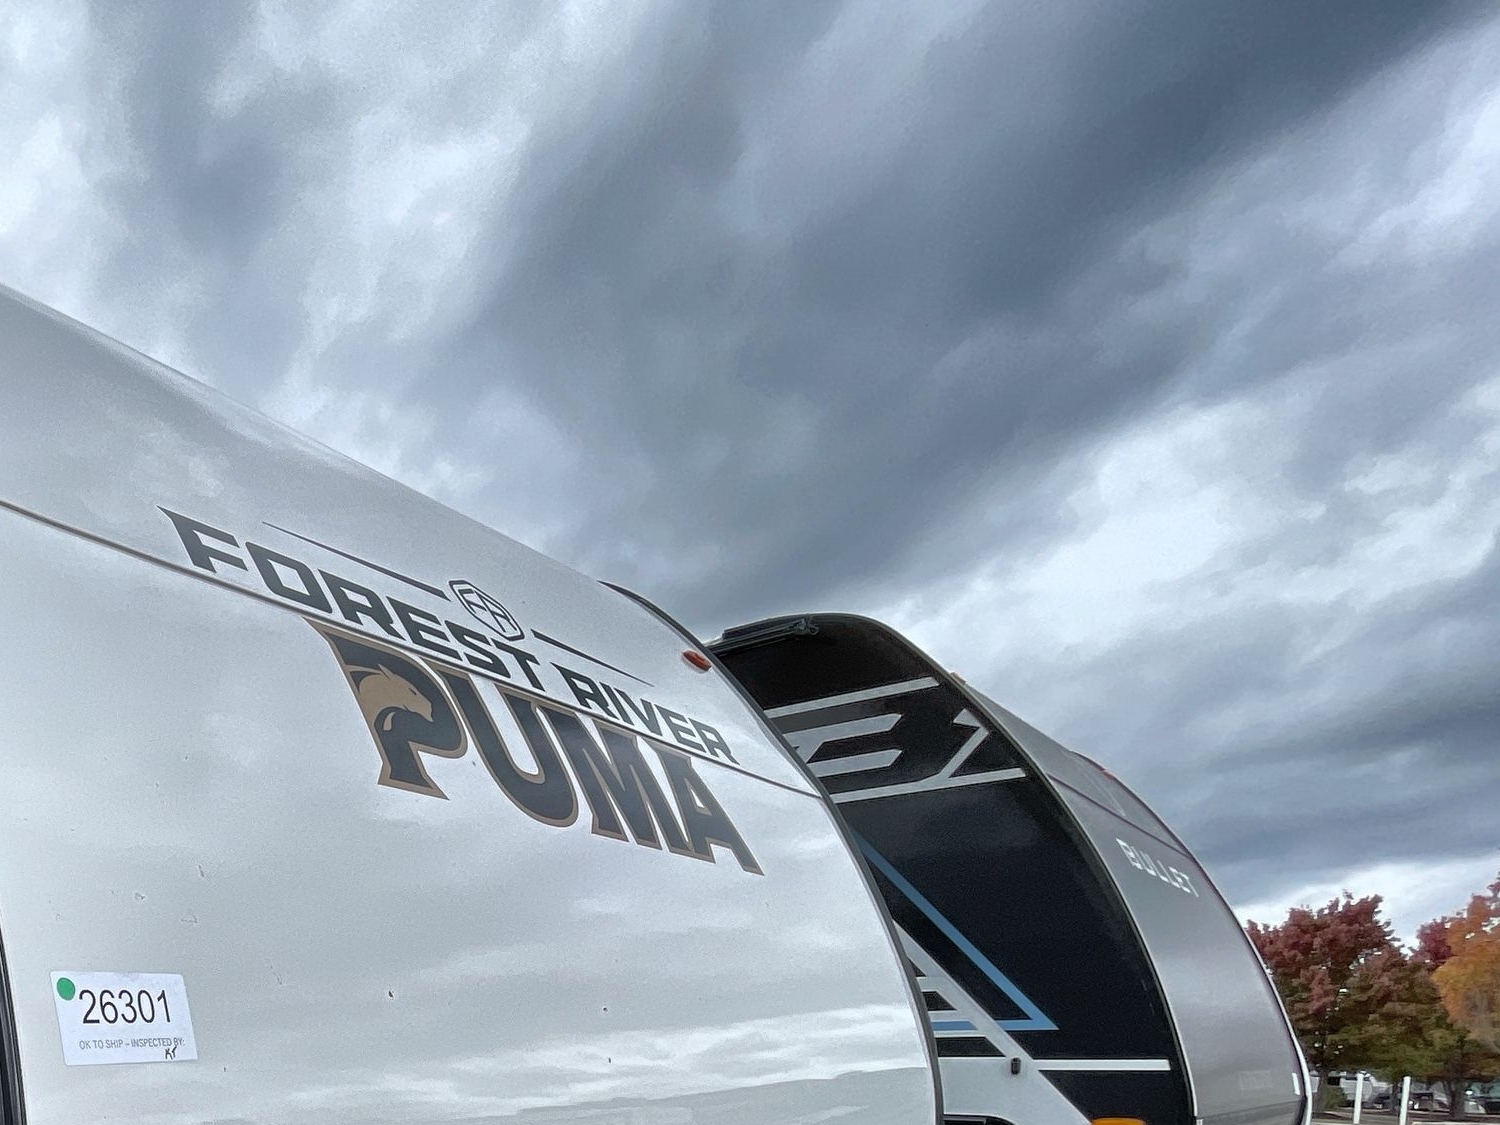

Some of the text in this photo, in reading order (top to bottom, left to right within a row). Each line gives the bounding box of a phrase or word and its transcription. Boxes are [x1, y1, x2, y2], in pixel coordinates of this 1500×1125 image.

[157, 505, 740, 765] FOREST RIVER
[304, 618, 764, 876] PUMA
[1115, 837, 1199, 898] BULLET
[78, 989, 171, 1024] 26301
[79, 1040, 92, 1050] OK
[93, 1039, 104, 1049] TO
[105, 1039, 124, 1049] SHIP
[131, 1037, 172, 1048] INSPECTED
[173, 1037, 186, 1047] BY:
